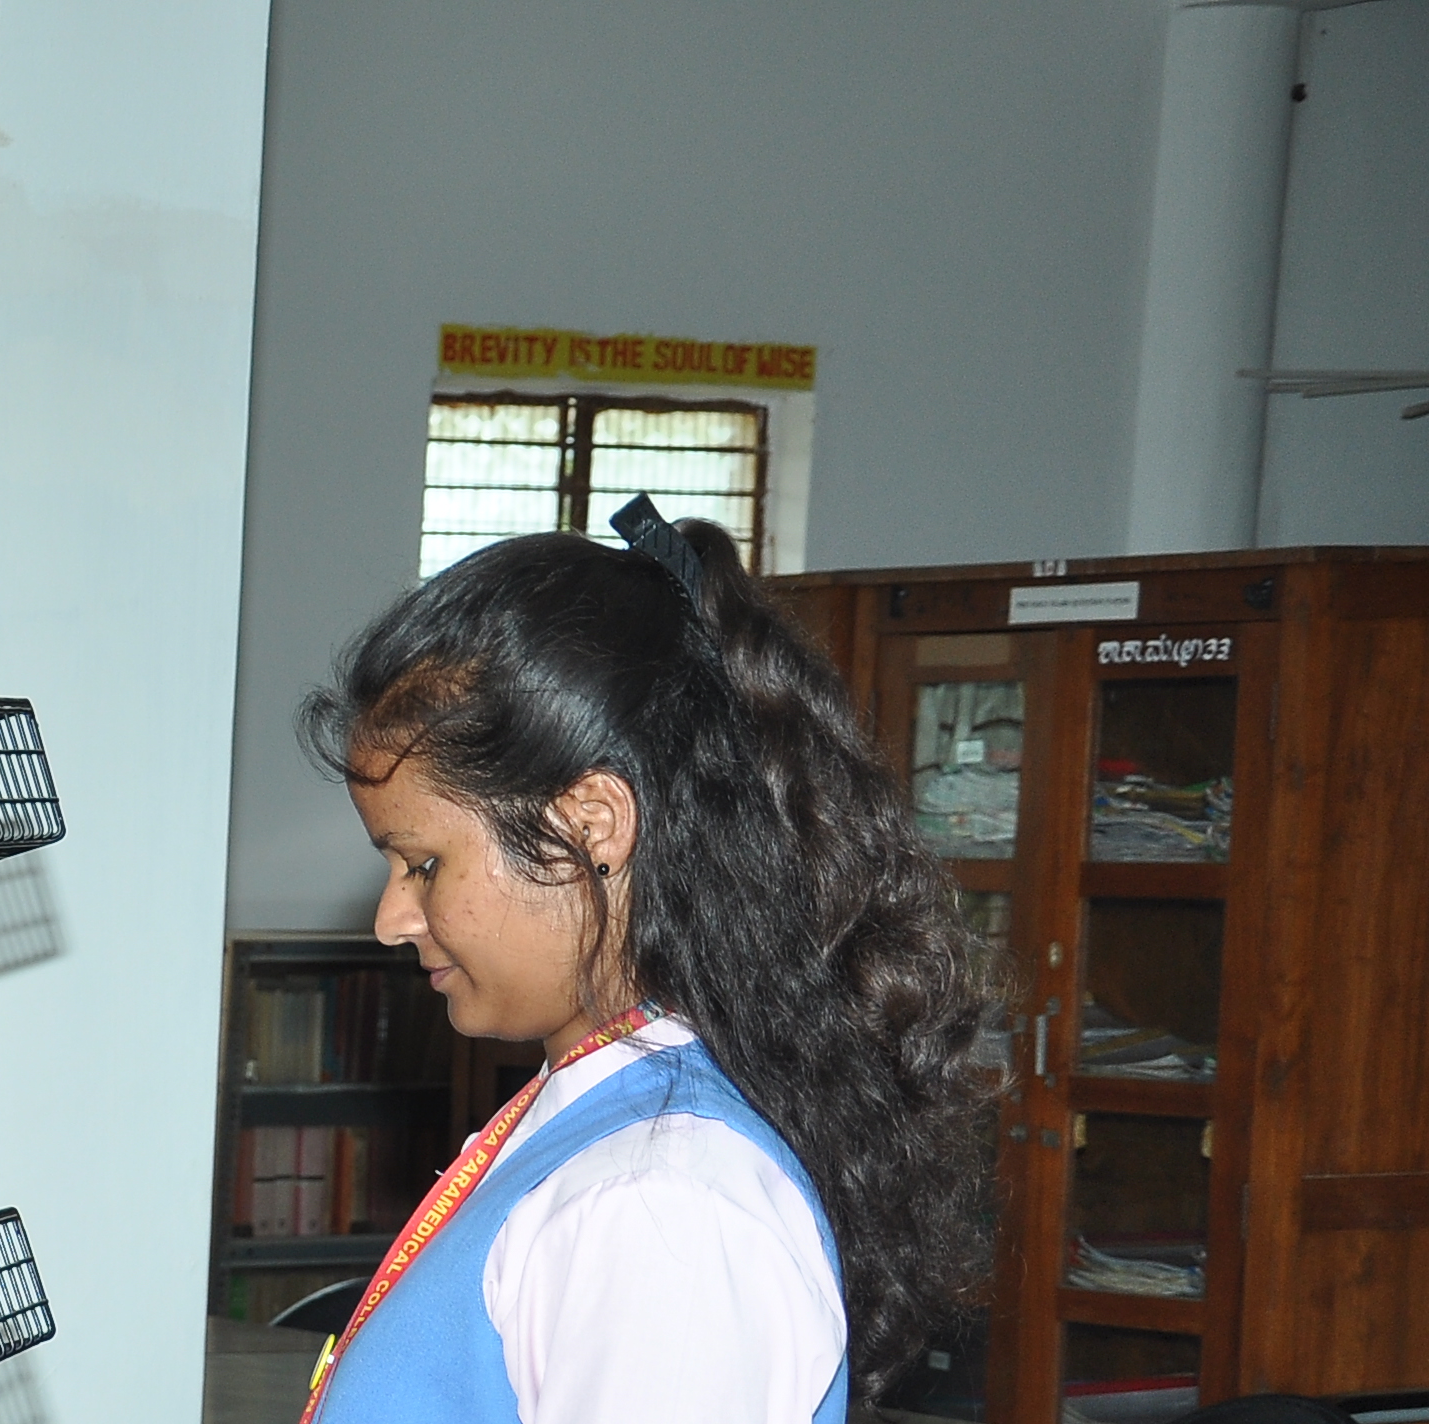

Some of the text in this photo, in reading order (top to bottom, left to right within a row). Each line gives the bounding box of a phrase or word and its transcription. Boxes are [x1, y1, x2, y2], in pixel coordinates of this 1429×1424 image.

[442, 333, 813, 379] BREVITY IS THE SOUL OF WISE
[385, 1149, 490, 1275] PARAMEDICAL
[344, 1278, 391, 1347] COLLE
